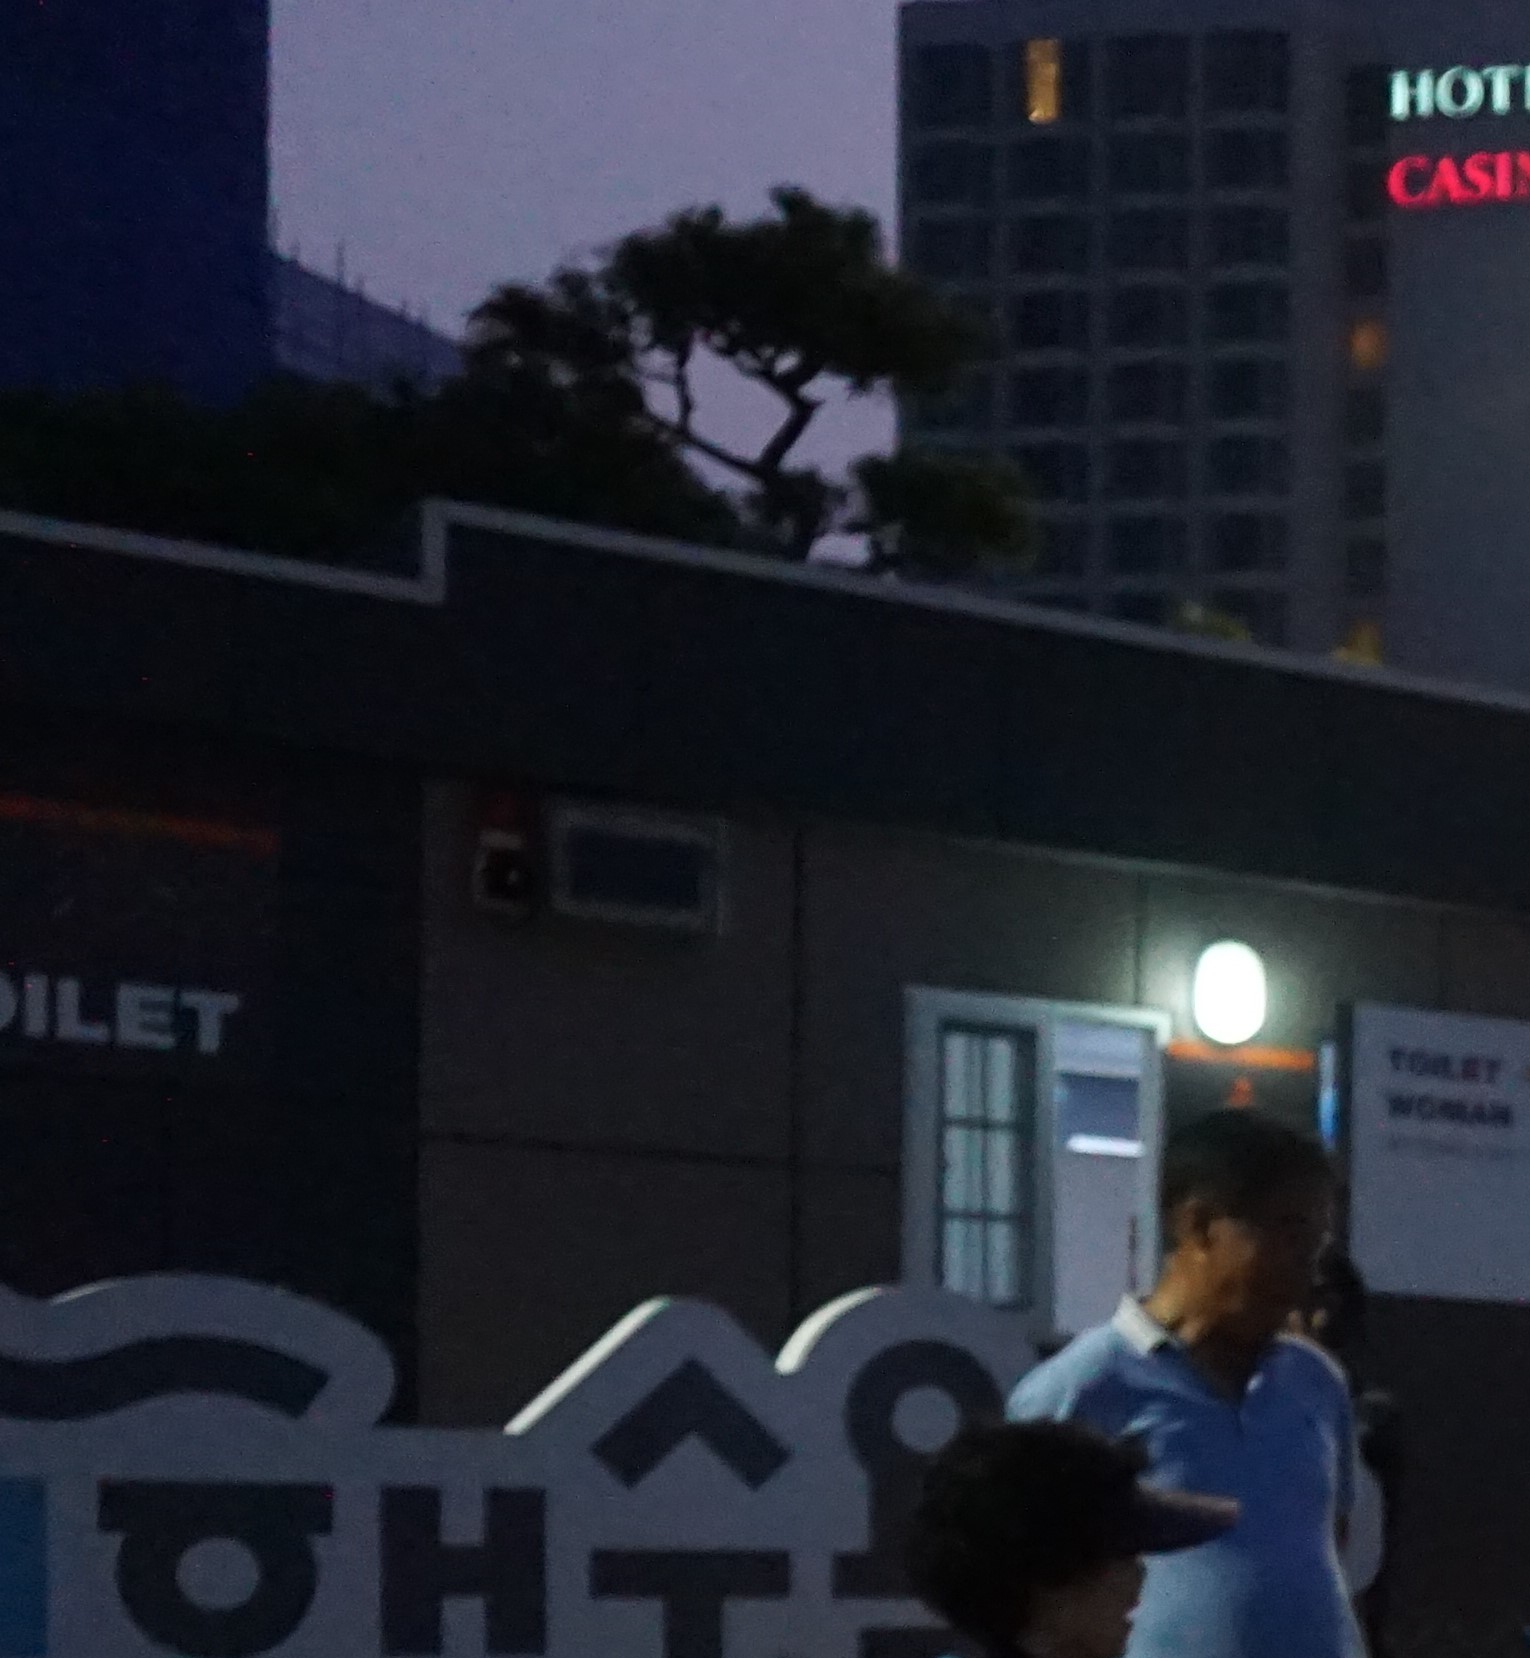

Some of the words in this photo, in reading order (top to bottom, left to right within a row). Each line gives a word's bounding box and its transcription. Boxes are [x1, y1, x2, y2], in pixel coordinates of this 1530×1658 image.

[0, 970, 241, 1055] ILET
[1388, 1047, 1502, 1086] TOILET
[1387, 1092, 1514, 1130] WOMAN
